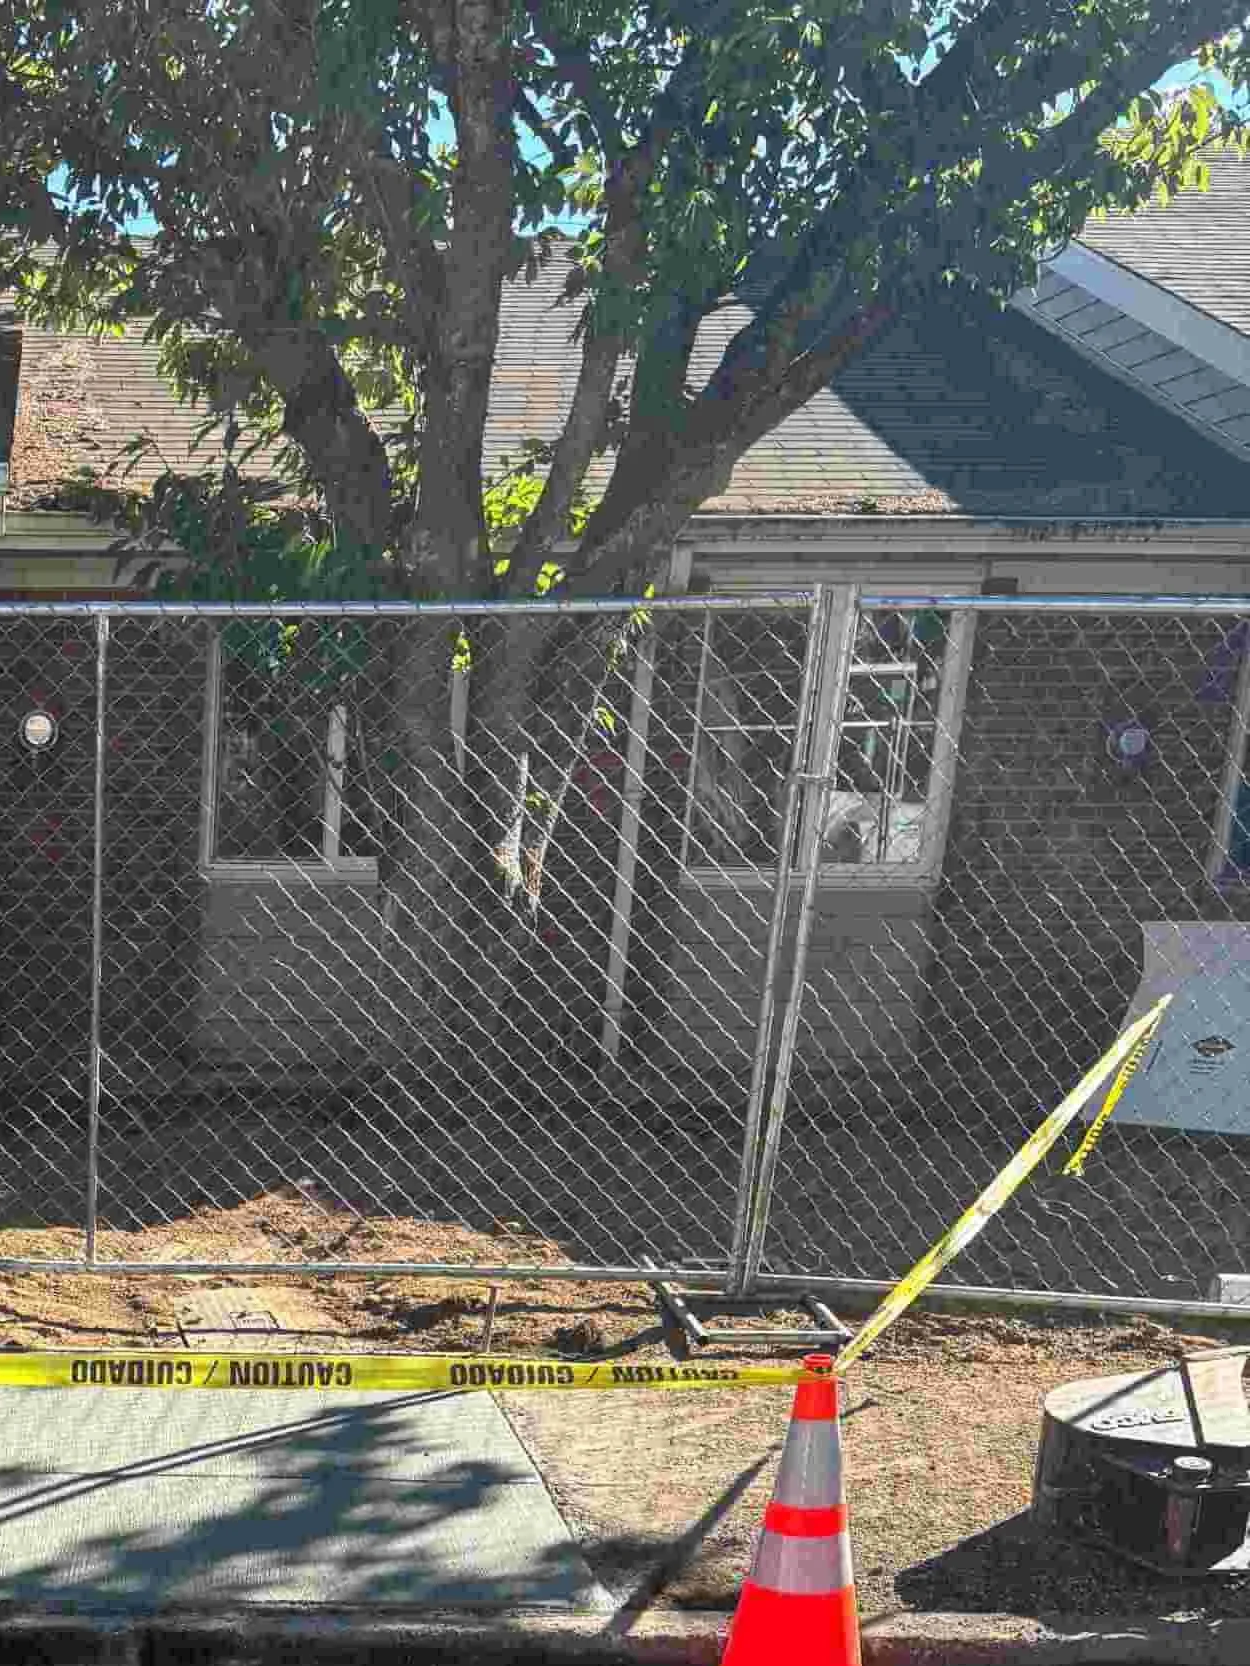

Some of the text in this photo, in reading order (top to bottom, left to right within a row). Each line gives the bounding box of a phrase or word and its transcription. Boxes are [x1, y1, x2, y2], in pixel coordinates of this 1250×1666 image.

[71, 1359, 192, 1386] CUIDADO
[230, 1361, 352, 1387] CAUTION
[450, 1362, 574, 1386] CUIDADO
